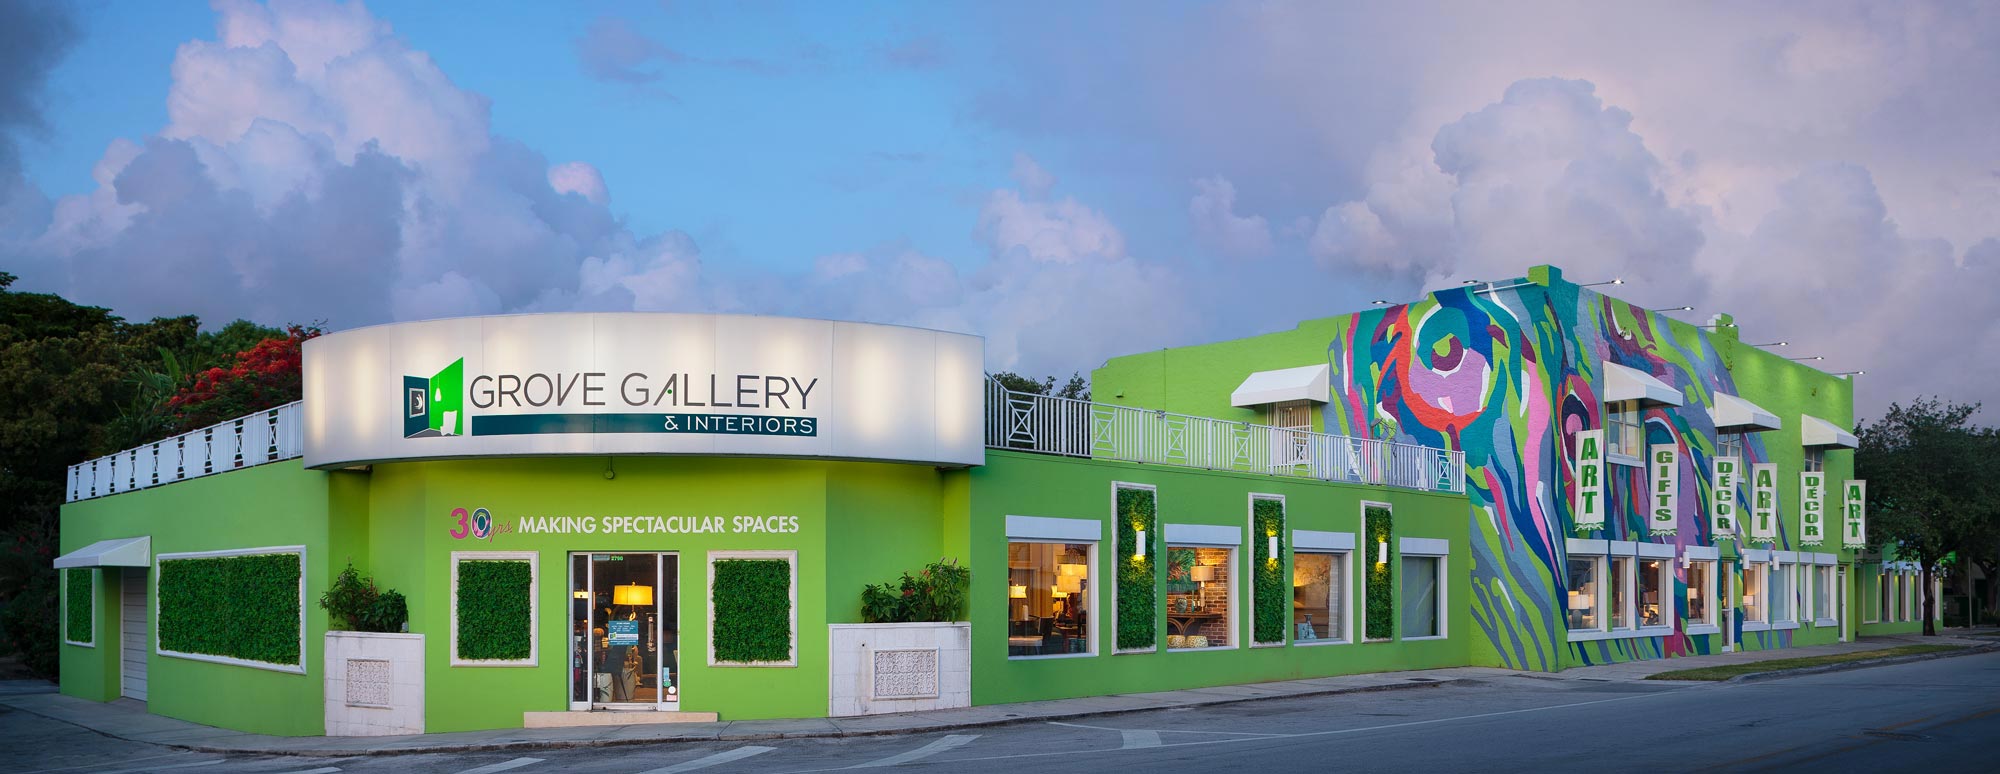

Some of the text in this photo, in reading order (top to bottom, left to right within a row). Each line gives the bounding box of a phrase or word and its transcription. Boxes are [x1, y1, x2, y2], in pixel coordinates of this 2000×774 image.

[469, 372, 818, 410] GROVE GALLERY
[664, 415, 813, 434] & INTERIORS
[1580, 437, 1599, 514] ART
[1656, 450, 1673, 522] GIFTS
[1716, 461, 1734, 530] DÉCOR
[1757, 469, 1772, 531] ART
[518, 516, 597, 534] MAKING
[602, 516, 725, 534] SPECTACULAR
[732, 516, 799, 533] SPACES
[1804, 476, 1820, 537] DÉCOR
[1848, 485, 1861, 538] ART
